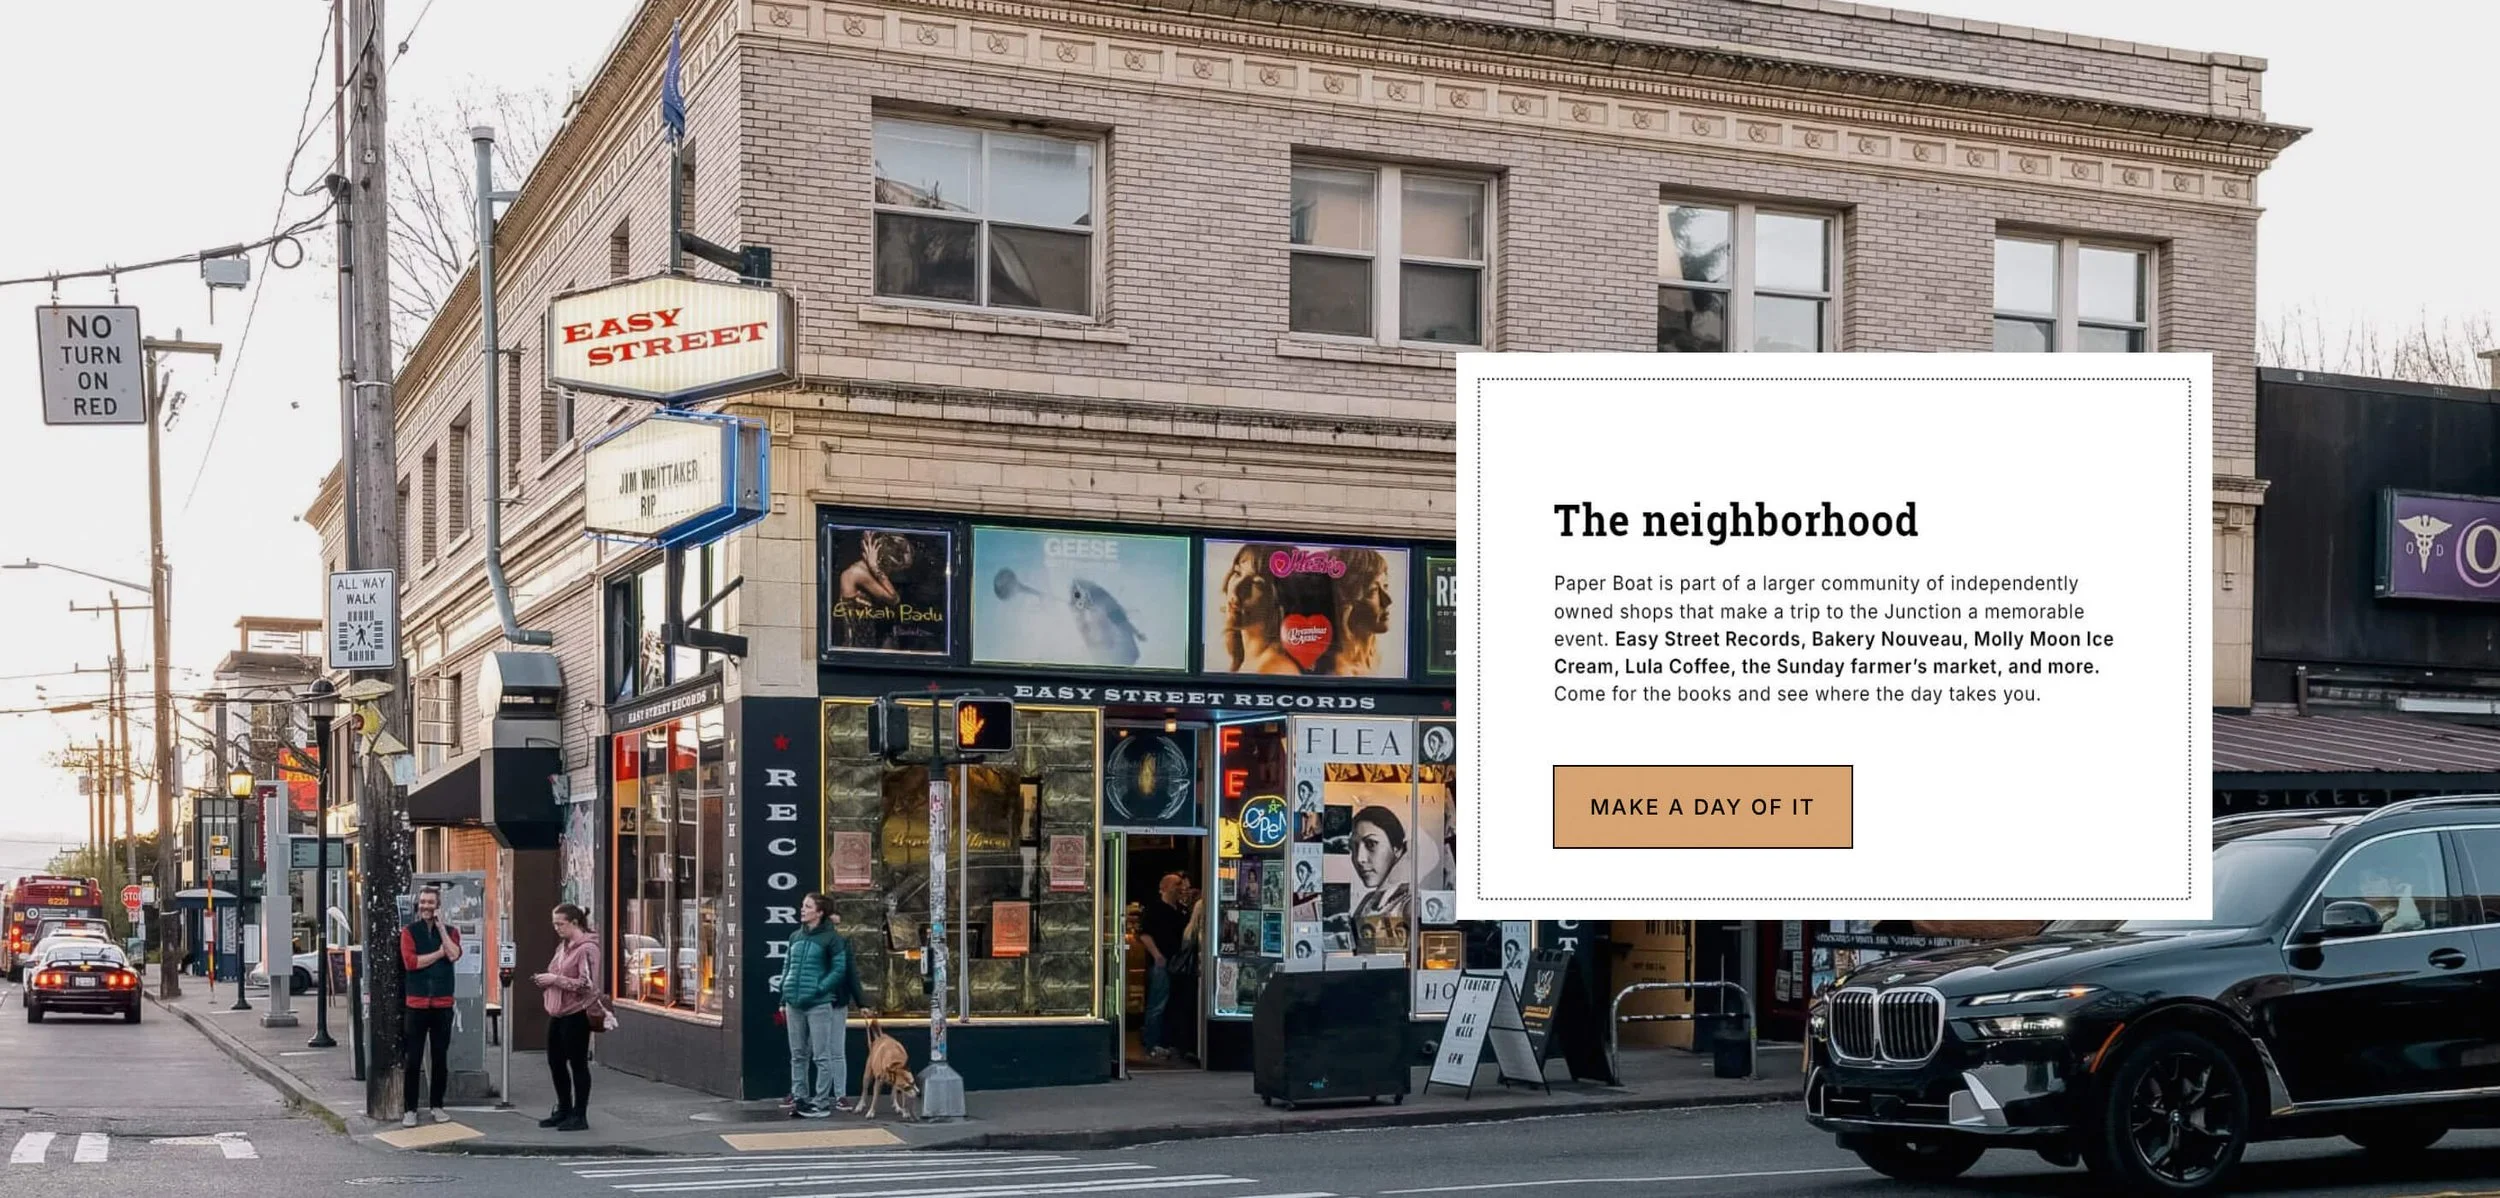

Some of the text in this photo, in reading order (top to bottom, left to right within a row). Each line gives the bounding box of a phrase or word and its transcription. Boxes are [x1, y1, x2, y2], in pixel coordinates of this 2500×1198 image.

[67, 315, 112, 338] NO
[562, 307, 684, 344] EASY
[61, 347, 121, 364] TURN
[587, 321, 768, 367] STREET
[79, 372, 108, 390] ON
[74, 398, 117, 415] RED
[619, 459, 698, 494] JIM WHITTAKER
[640, 495, 657, 517] RIP
[1044, 537, 1119, 560] GEESE
[337, 577, 386, 590] ALL WAY
[346, 593, 377, 605] WALK
[900, 604, 943, 622] Badu
[628, 690, 707, 723] EASY STREET RECORDS
[1014, 684, 1376, 710] EASY STREET RECORDS
[1307, 728, 1401, 756] FLEA
[727, 761, 736, 999] WALK ALL WAYS
